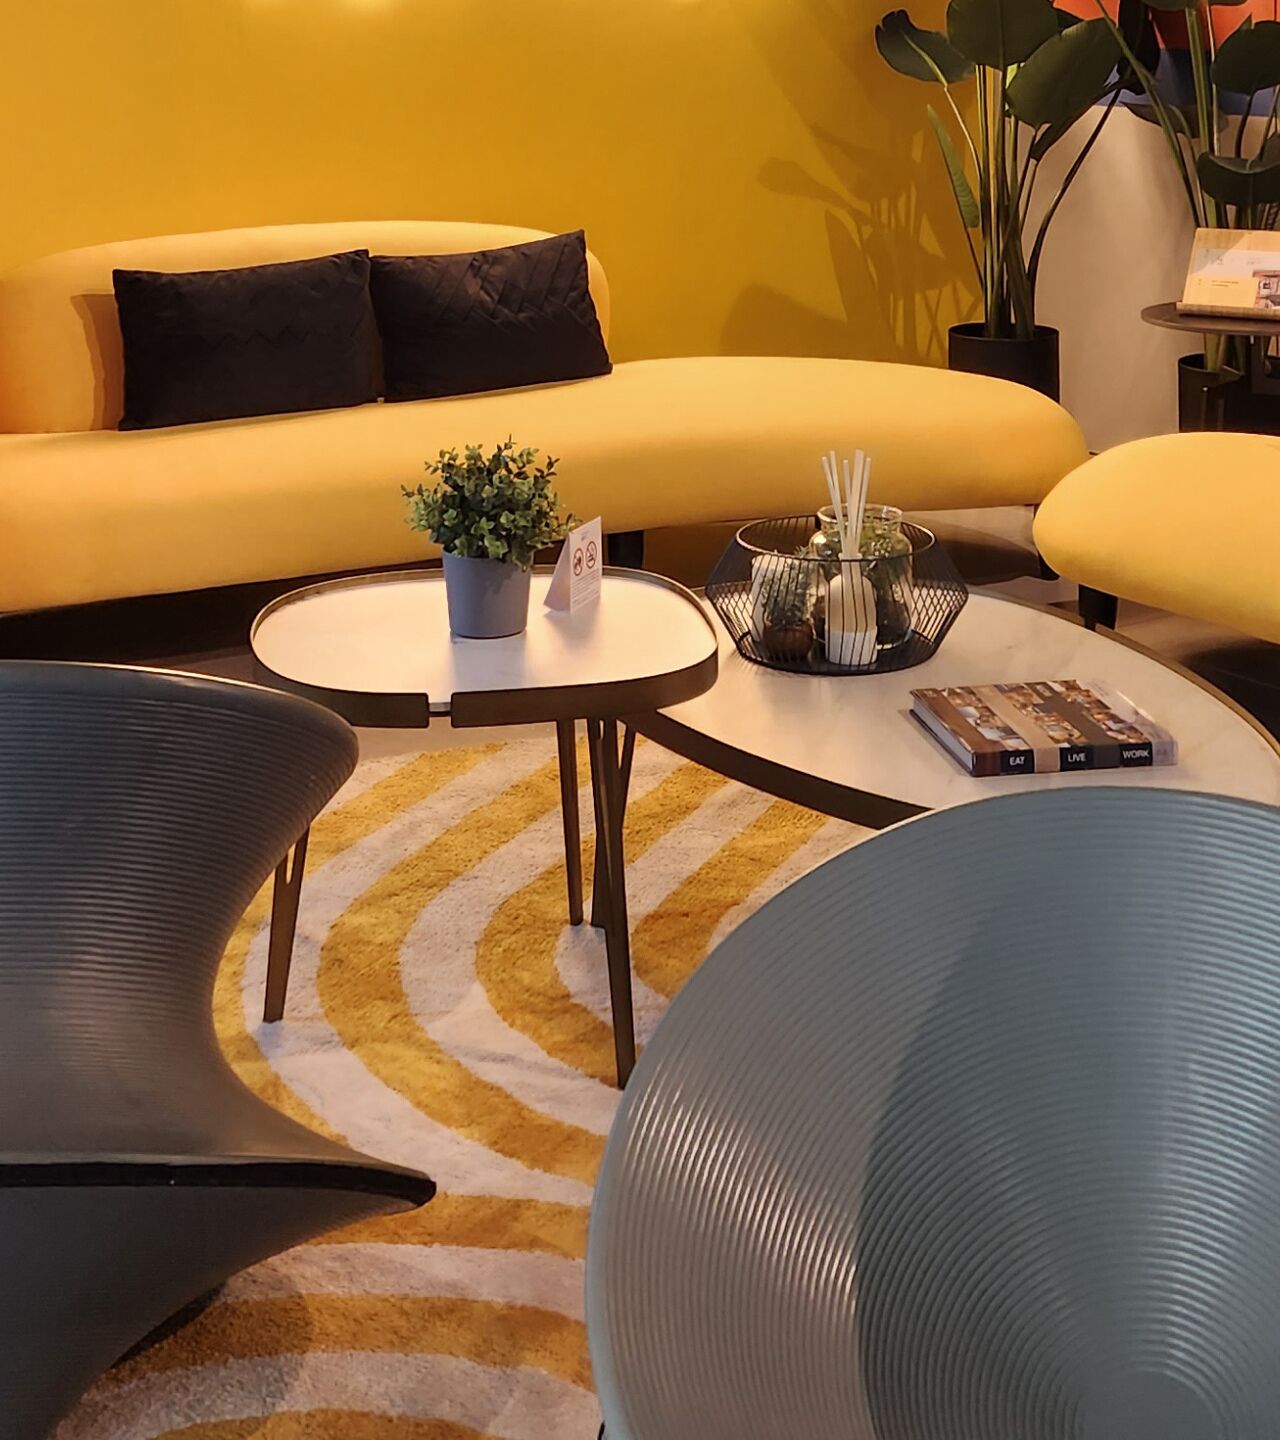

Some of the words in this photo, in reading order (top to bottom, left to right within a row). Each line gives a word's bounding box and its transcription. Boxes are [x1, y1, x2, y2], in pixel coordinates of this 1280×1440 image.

[1009, 756, 1025, 766] EAT
[1067, 753, 1086, 763] LIVE
[1122, 749, 1150, 760] WORK
